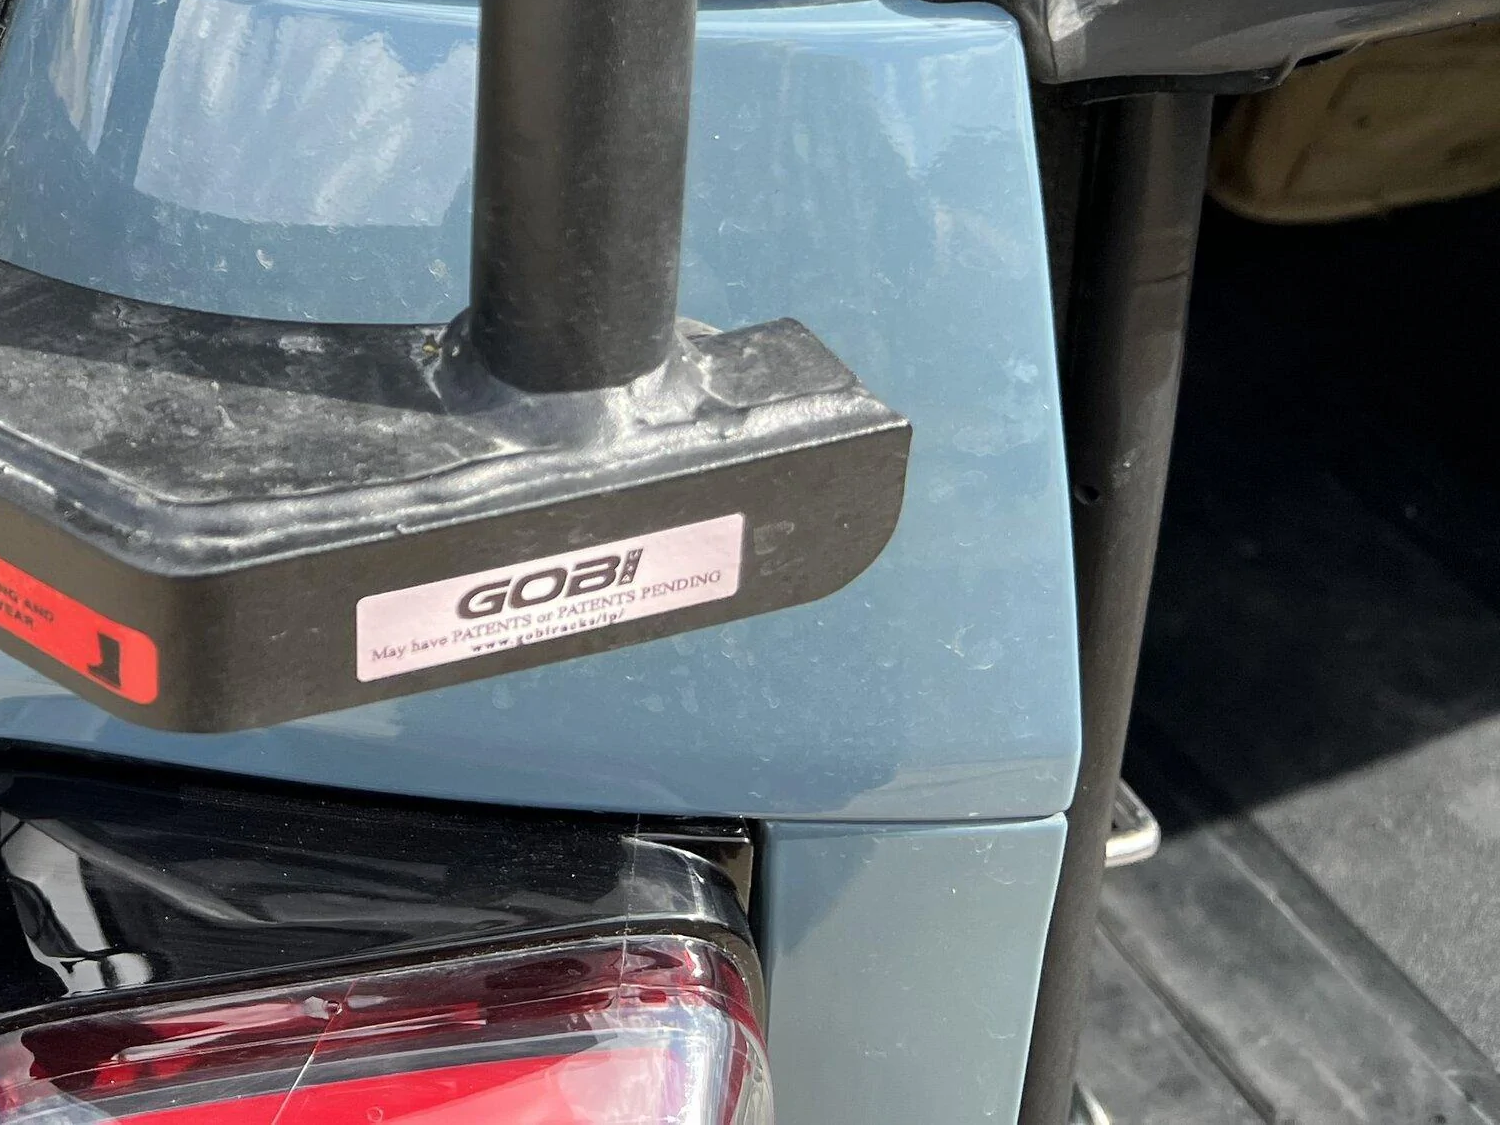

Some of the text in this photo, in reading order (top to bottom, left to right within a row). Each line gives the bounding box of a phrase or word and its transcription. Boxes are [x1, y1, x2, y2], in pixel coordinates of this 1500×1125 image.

[23, 598, 54, 623] AND
[371, 569, 722, 662] May have PATENTS or PATENTS PENDING
[455, 547, 644, 621] GOBI
